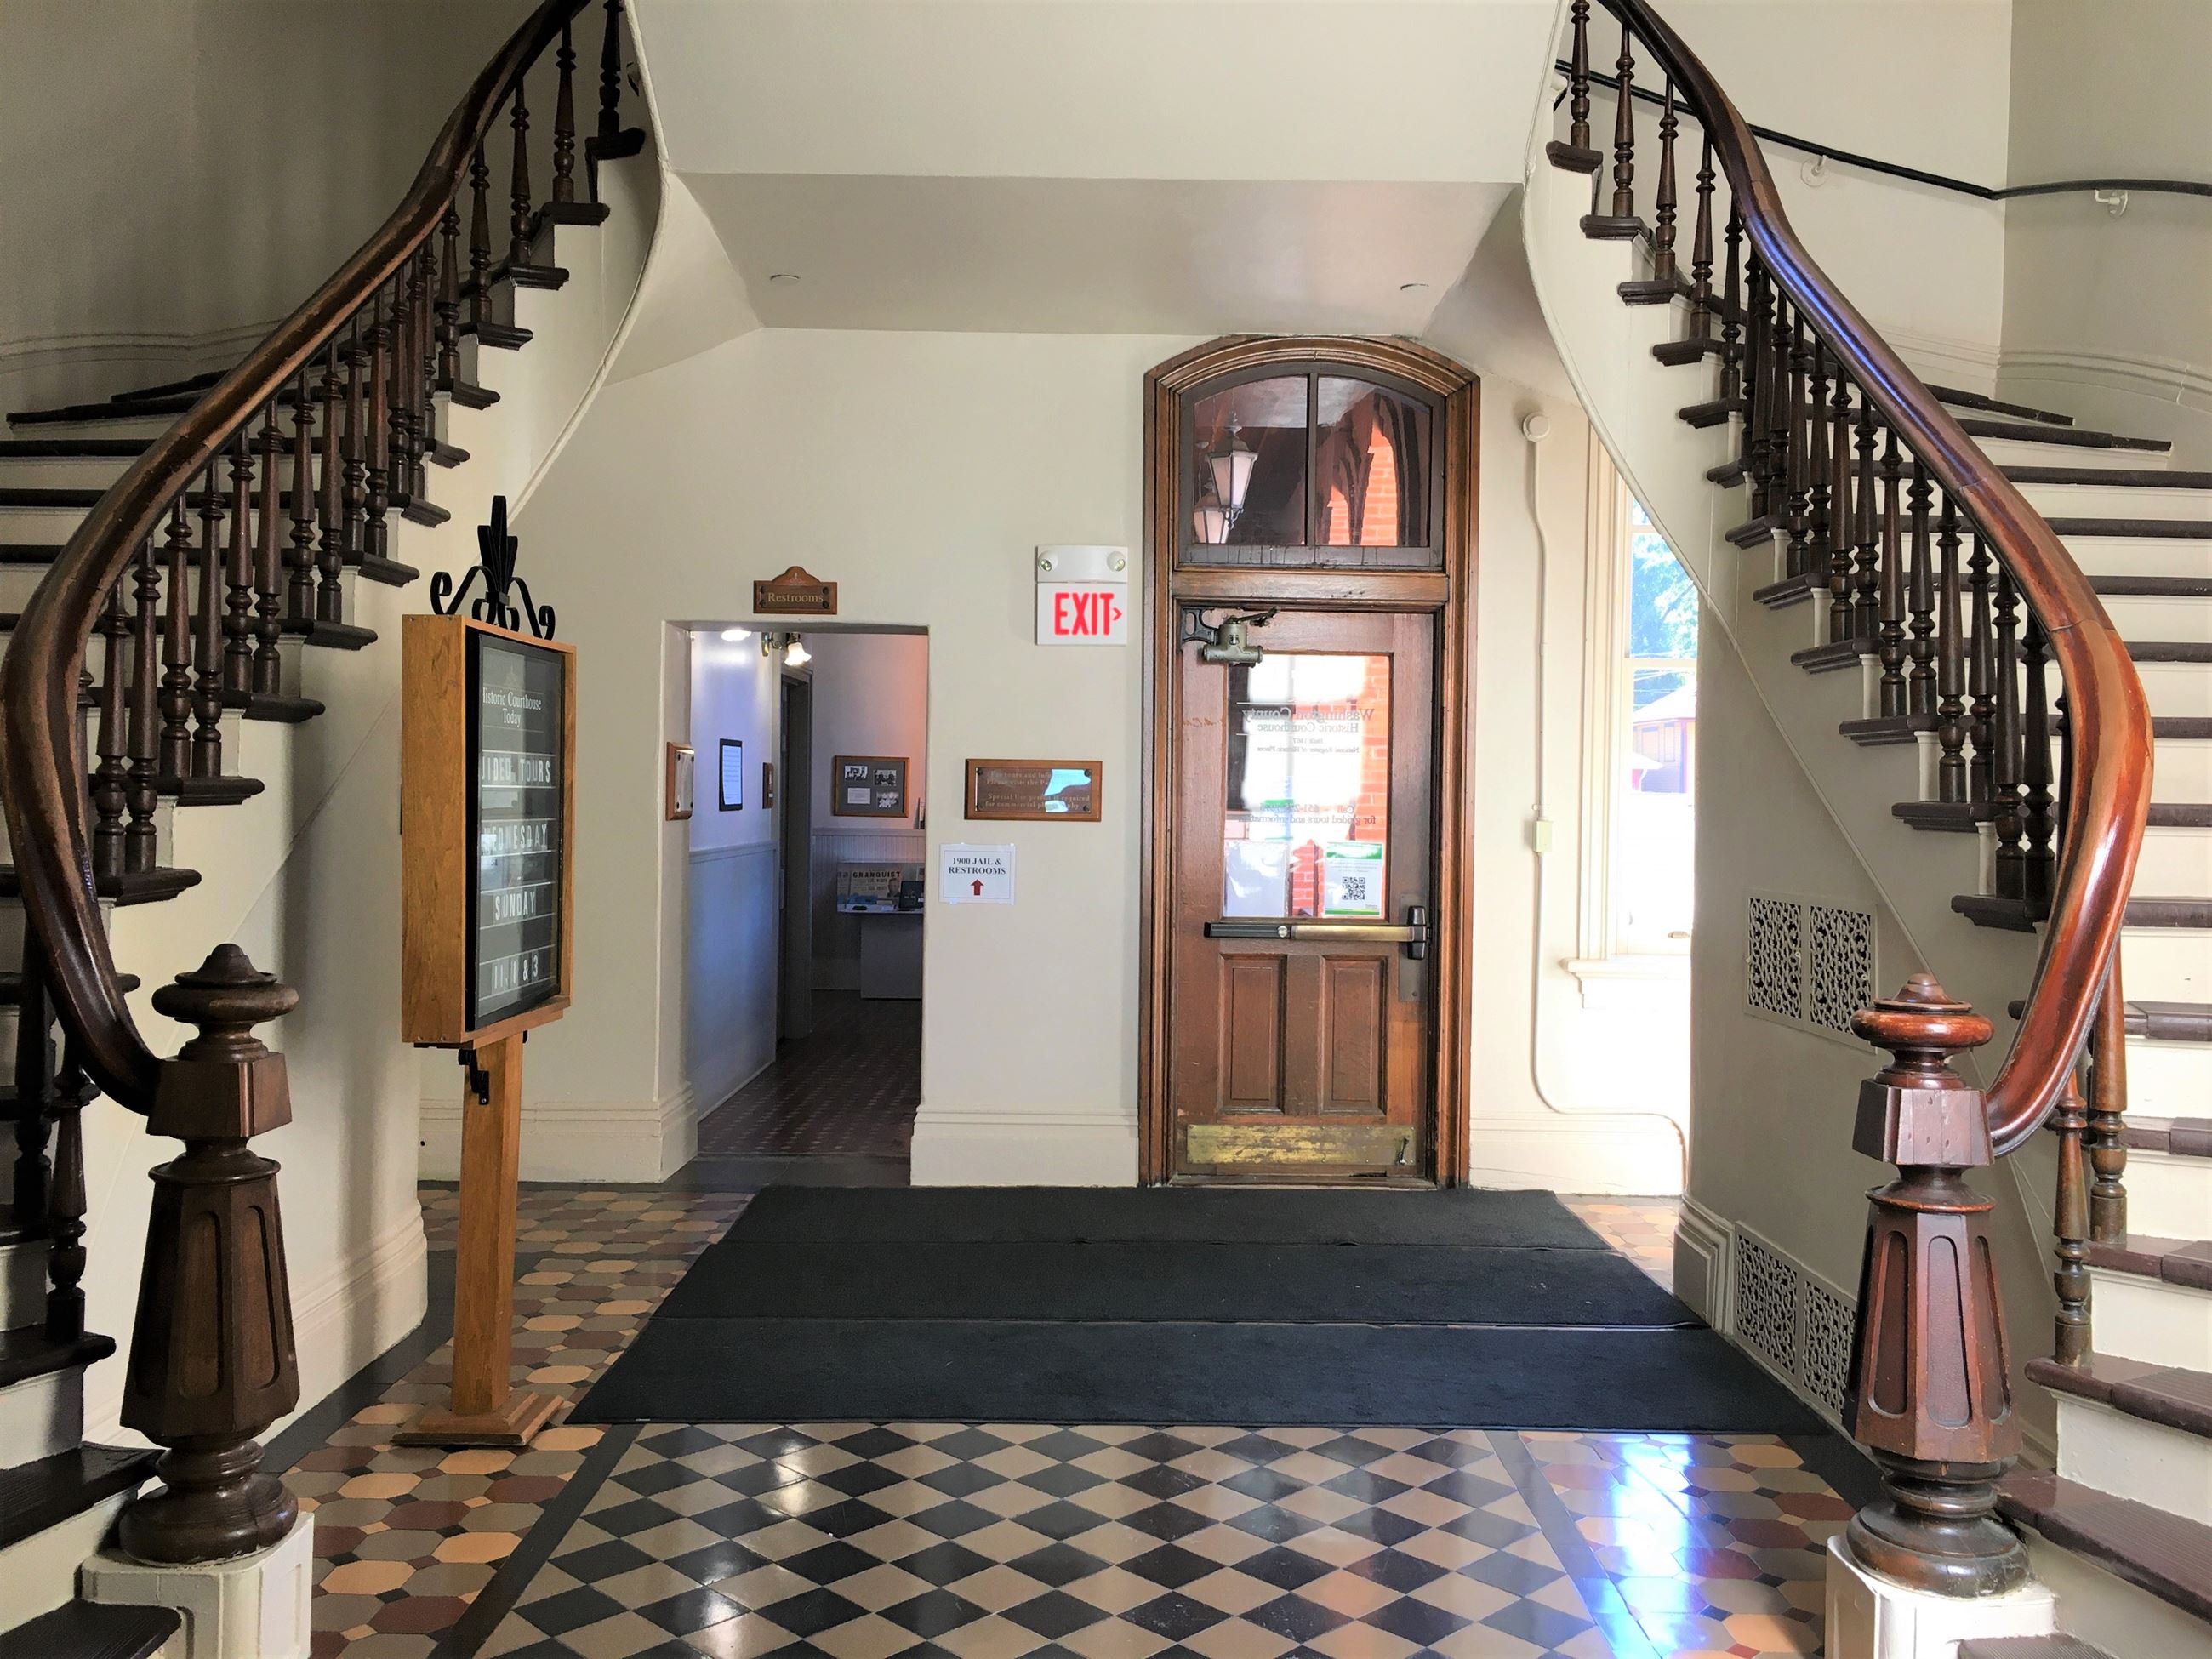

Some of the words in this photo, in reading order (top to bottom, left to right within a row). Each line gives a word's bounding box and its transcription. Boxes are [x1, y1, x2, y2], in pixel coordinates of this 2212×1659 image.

[767, 592, 824, 603] Restrooms
[1054, 592, 1115, 636] EXIT
[507, 691, 542, 711] Courthouse
[502, 708, 522, 728] Today
[482, 756, 511, 781] IDED
[519, 758, 550, 784] TOURS
[948, 866, 1006, 875] RESTROOMS
[952, 857, 971, 865] 1900
[995, 858, 1002, 866] &
[495, 891, 535, 921] SUNDAY
[533, 955, 539, 978] 3
